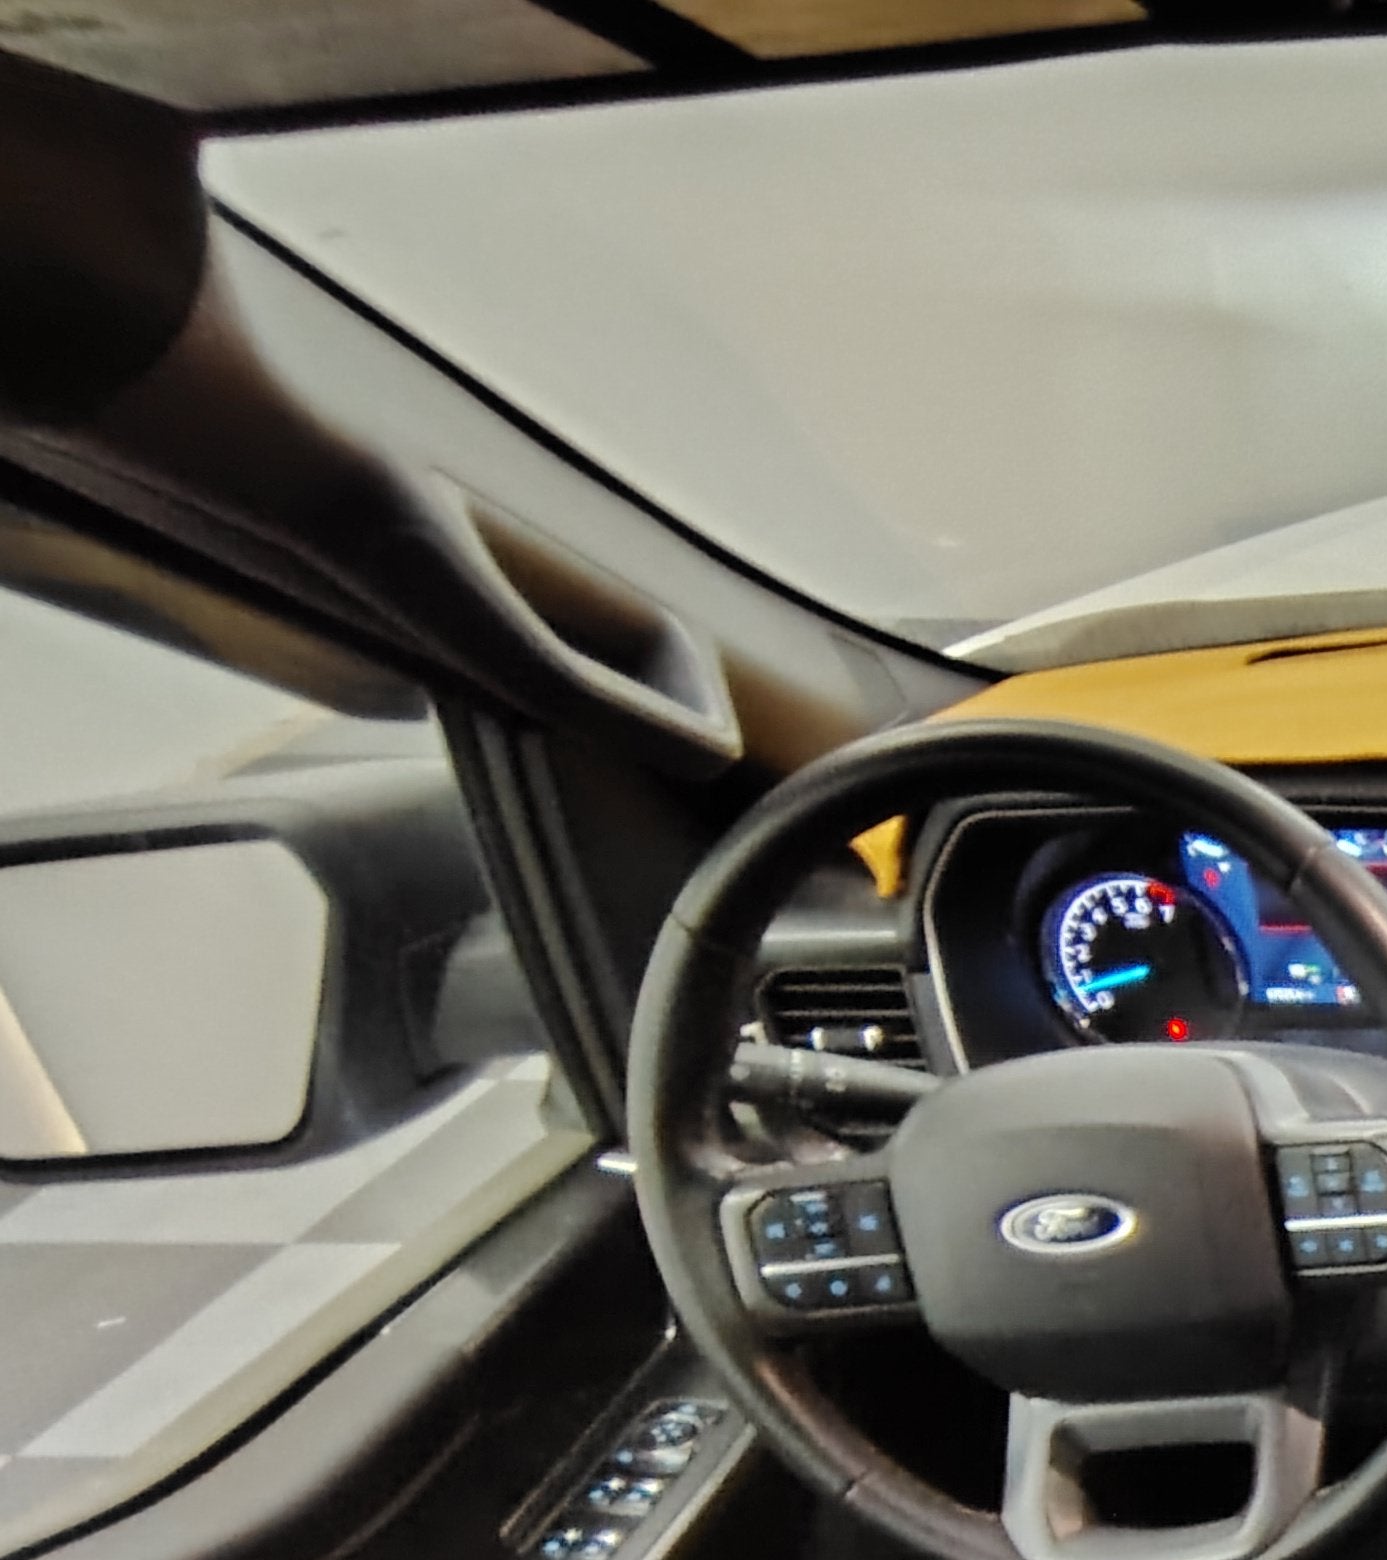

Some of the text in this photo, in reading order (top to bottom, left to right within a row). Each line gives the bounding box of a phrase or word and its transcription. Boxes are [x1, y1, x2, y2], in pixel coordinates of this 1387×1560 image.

[1111, 897, 1128, 916] 5
[1135, 897, 1153, 914] 6
[1159, 904, 1175, 924] 7
[1080, 923, 1098, 942] 3
[1076, 943, 1093, 963] 2
[1096, 990, 1115, 1010] 0
